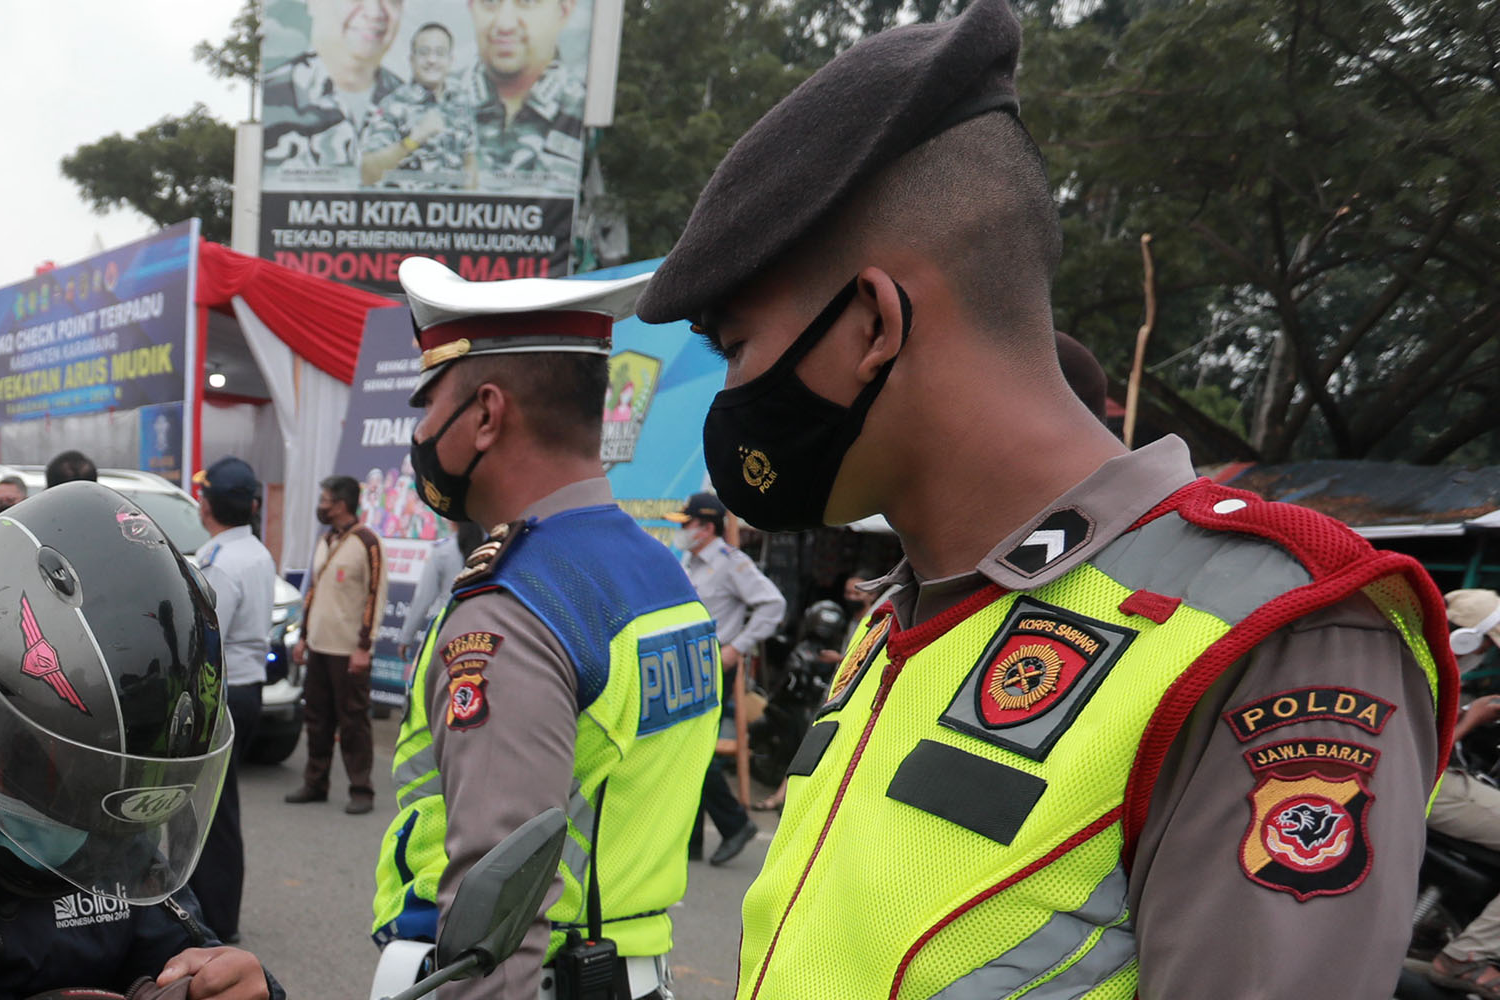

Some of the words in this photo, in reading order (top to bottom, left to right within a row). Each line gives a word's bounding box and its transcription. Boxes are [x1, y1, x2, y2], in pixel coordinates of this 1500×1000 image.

[288, 200, 358, 225] MARI
[361, 201, 423, 227] KITA
[426, 202, 543, 230] DUKUNG
[271, 229, 333, 248] TEKAD
[335, 230, 450, 250] PEMERINTAH
[452, 232, 556, 253] WUJUDKAN
[459, 253, 550, 282] MAJU
[16, 322, 57, 350] CHECK
[57, 311, 98, 340] POINT
[99, 292, 165, 329] TERPADU
[63, 356, 108, 390] ARUS
[111, 342, 174, 381] MUDIK
[361, 417, 417, 447] TIDAK
[759, 470, 778, 494] POLRI
[448, 633, 492, 650] POLRES
[1018, 618, 1056, 632] KORPS
[1055, 624, 1100, 656] SABHARA
[639, 633, 717, 720] POLISI
[1241, 692, 1379, 732] POLDA
[1257, 743, 1308, 766] JAWA
[1316, 743, 1373, 766] BARAT
[77, 882, 129, 915] blibli
[55, 916, 95, 928] INDONESIA
[96, 913, 114, 923] OPEN
